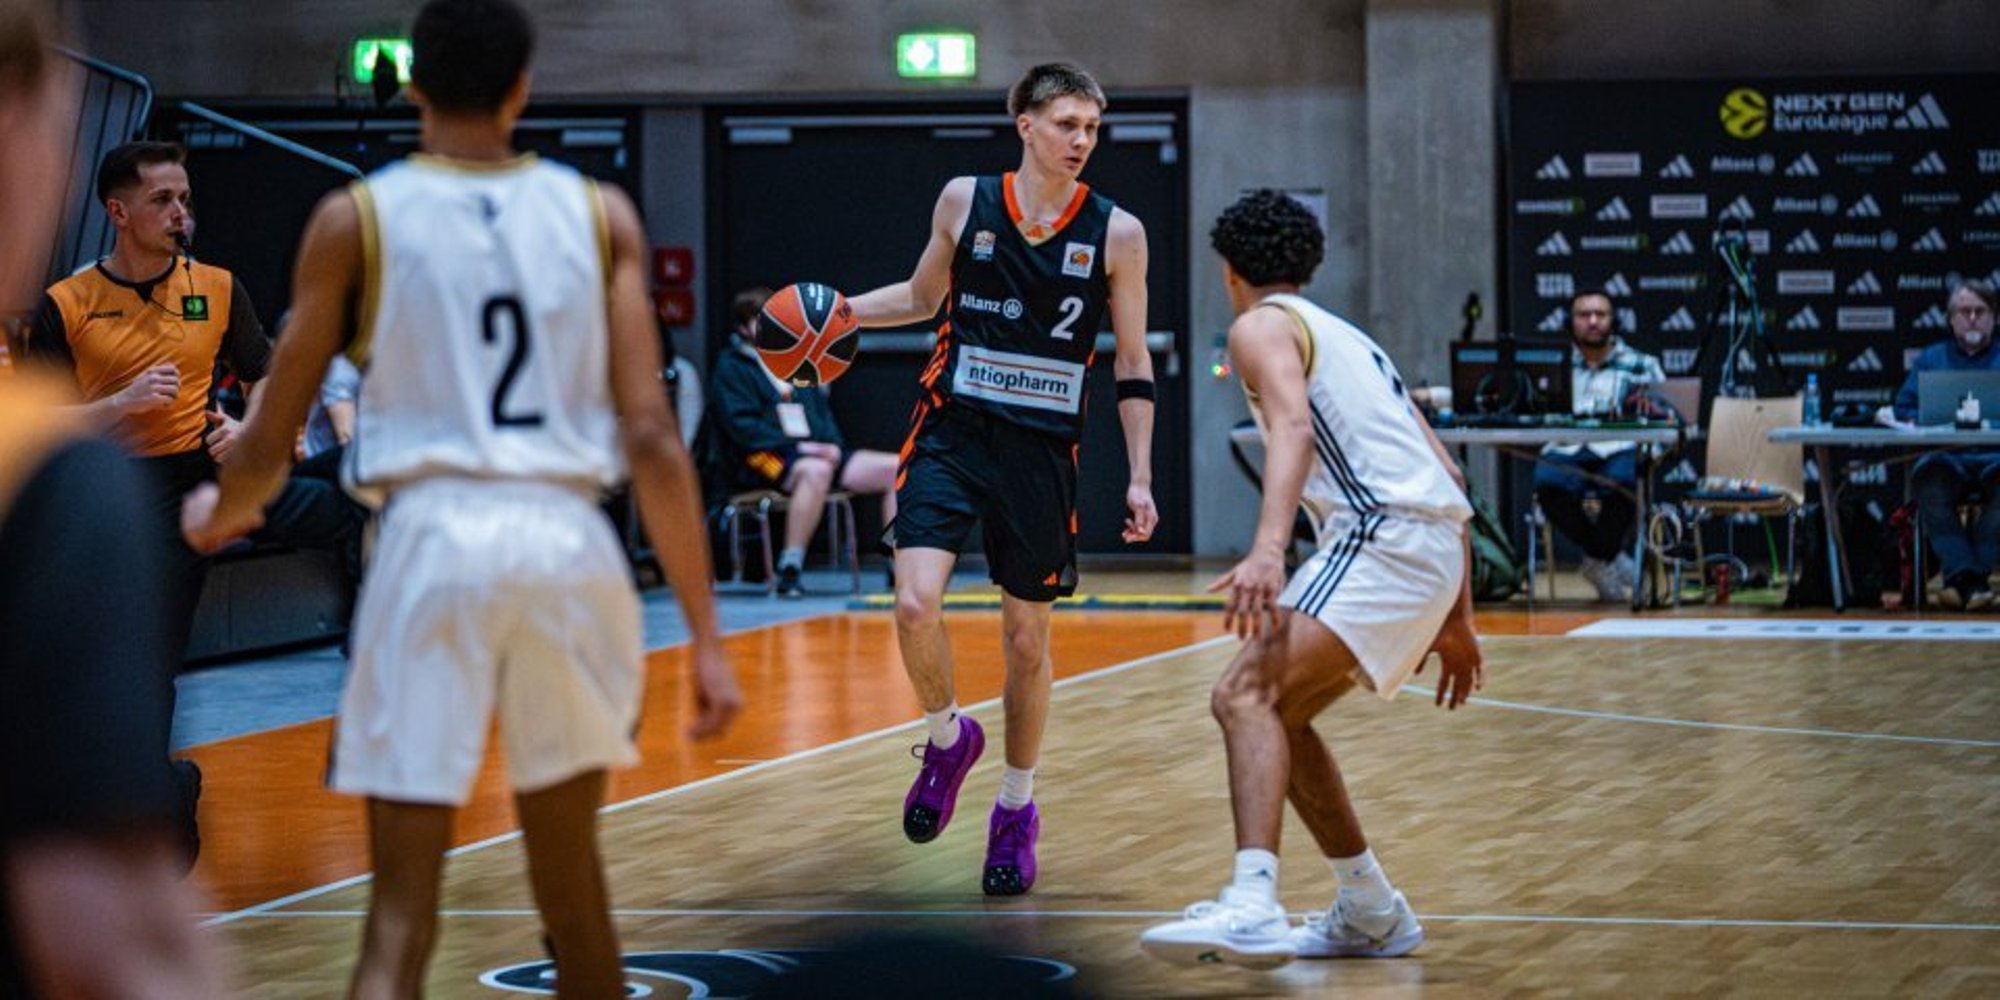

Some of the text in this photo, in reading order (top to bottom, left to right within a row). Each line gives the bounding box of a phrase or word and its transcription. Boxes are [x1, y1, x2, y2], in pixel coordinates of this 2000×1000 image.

[1773, 92, 1904, 112] NEXT GEN
[1774, 112, 1888, 134] EuroLeague
[1711, 155, 1755, 171] Allianz
[1832, 232, 1878, 248] Allianz
[959, 293, 1001, 313] Allianz
[1050, 297, 1084, 340] 2
[481, 295, 544, 427] 2
[969, 365, 1069, 395] ntiopharm
